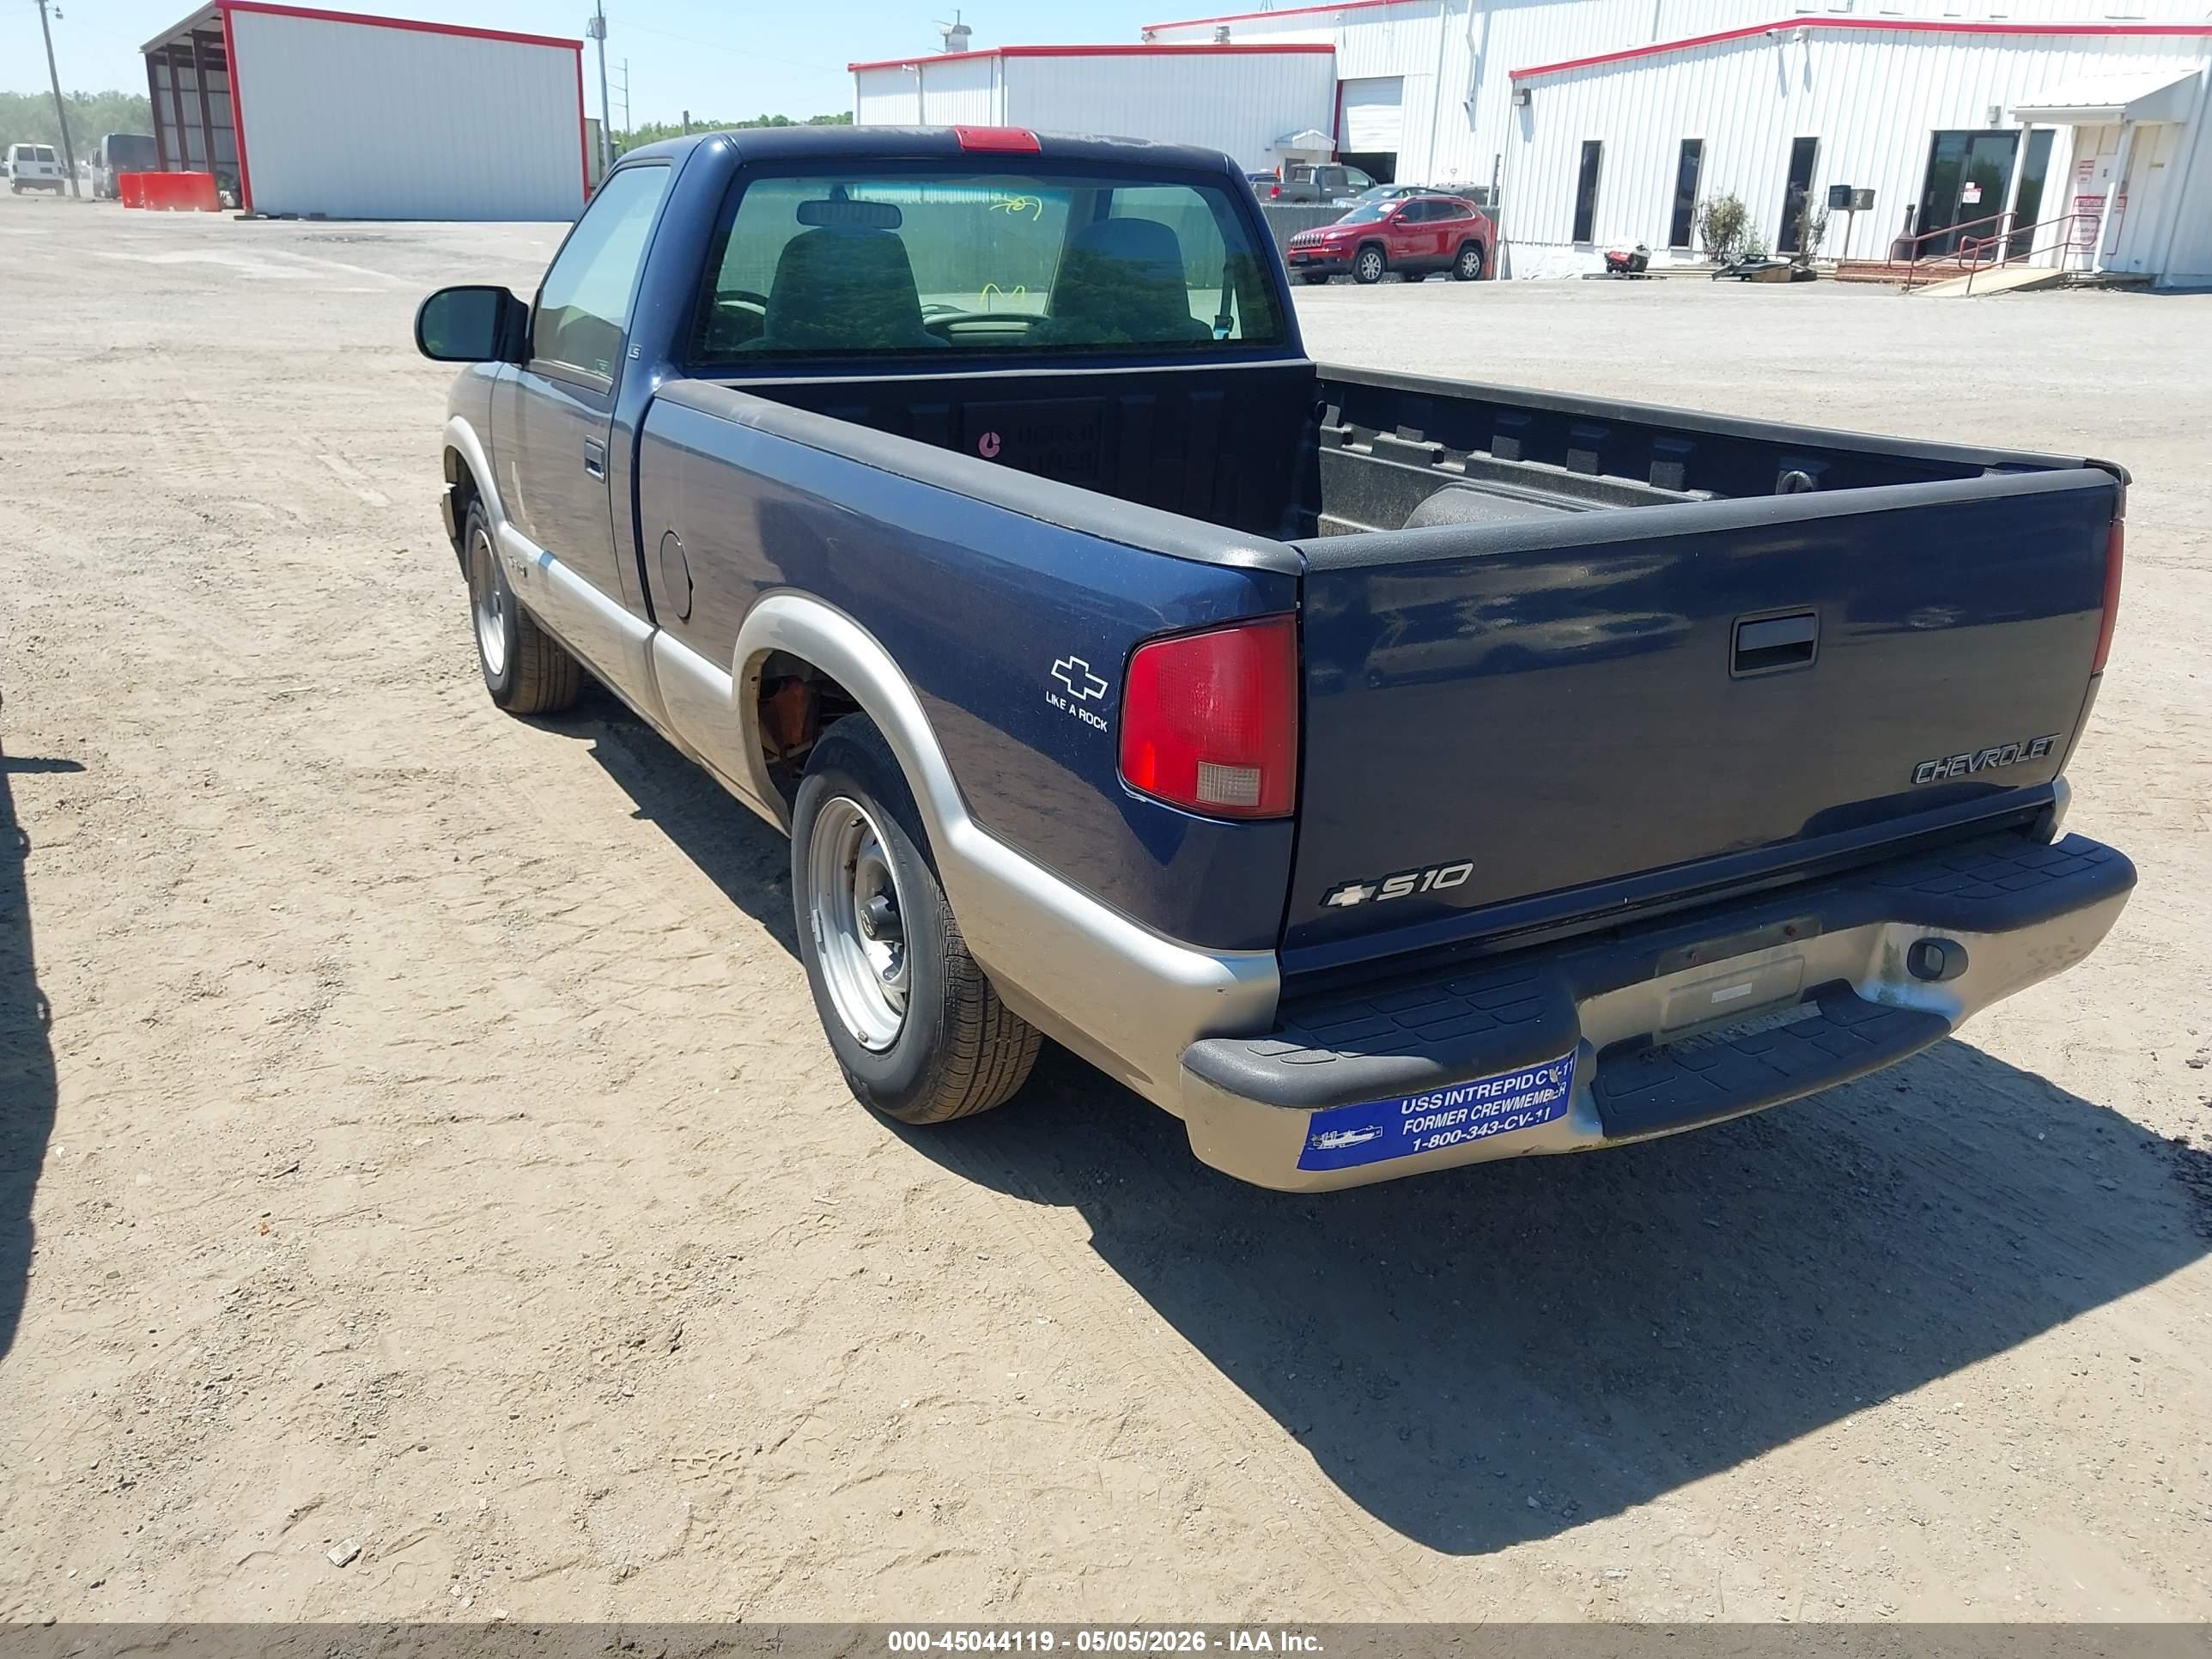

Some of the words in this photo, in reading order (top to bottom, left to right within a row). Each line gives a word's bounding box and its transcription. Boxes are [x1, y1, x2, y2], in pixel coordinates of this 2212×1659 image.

[1046, 690, 1066, 711] LIKE
[1069, 704, 1077, 716] A
[1079, 708, 1108, 732] ROCK
[1911, 732, 2063, 784] CHEVROLET
[1376, 860, 1474, 902] S10
[1401, 1094, 1443, 1115] USS
[1444, 1074, 1534, 1107] INTREPID
[1402, 1109, 1468, 1135] FORMER
[1413, 1107, 1551, 1152] 1-800-343-CV-11
